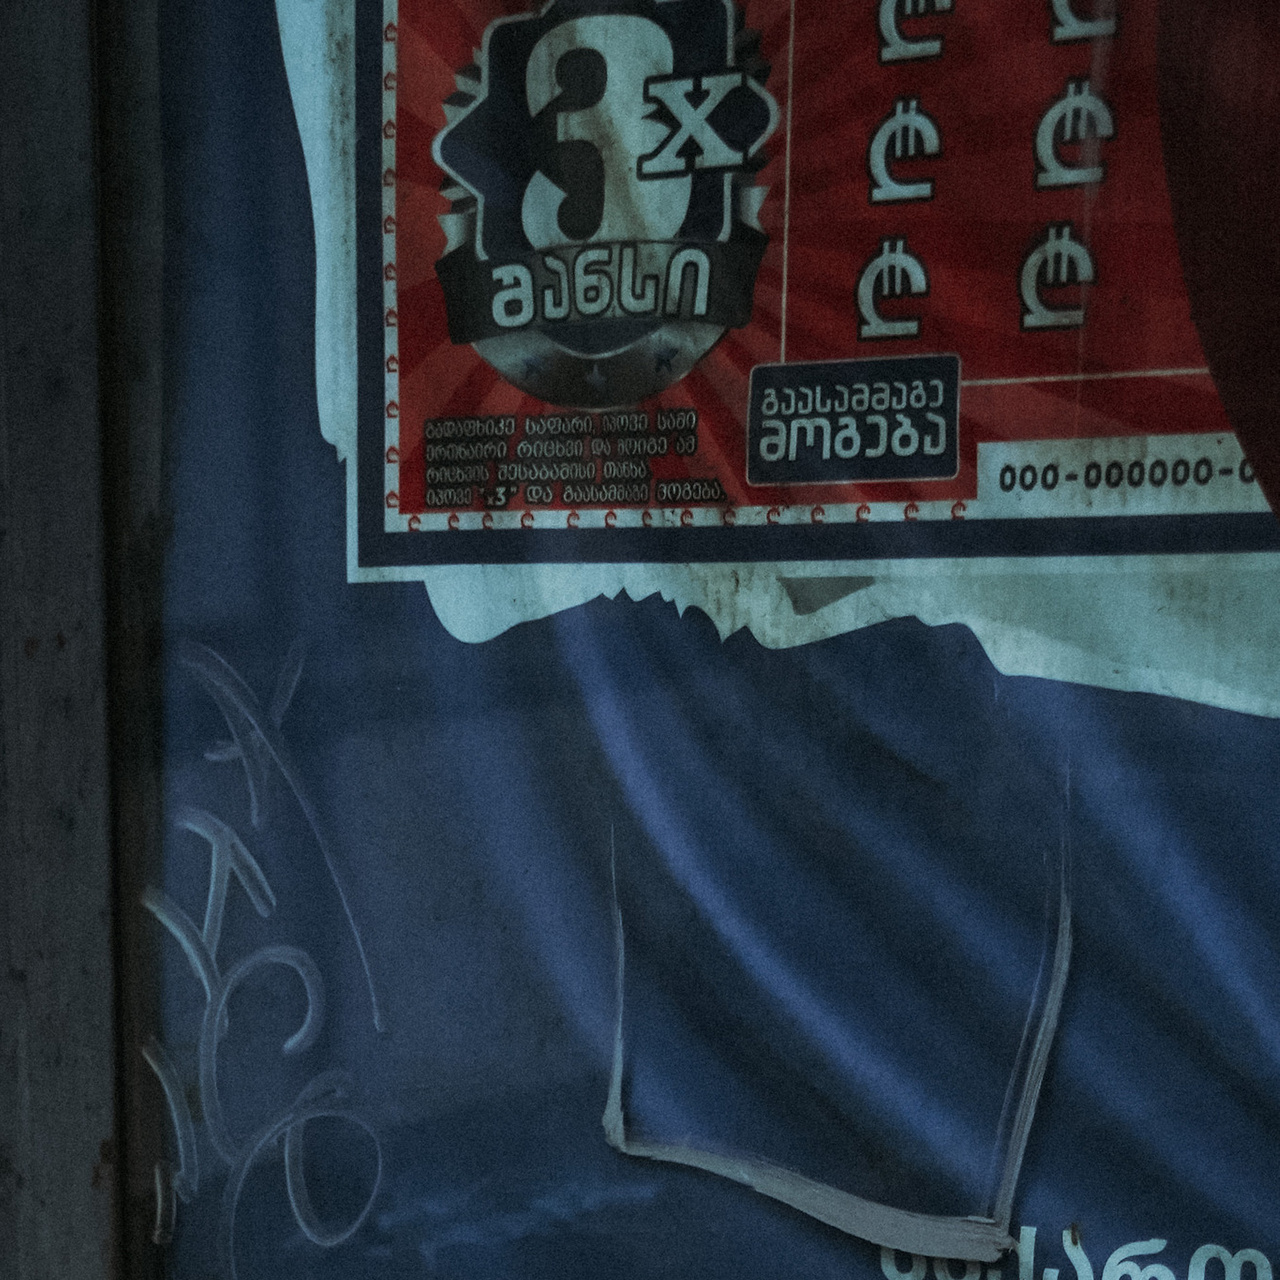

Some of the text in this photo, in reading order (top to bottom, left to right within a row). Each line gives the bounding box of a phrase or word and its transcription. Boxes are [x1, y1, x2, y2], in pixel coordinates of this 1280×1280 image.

[490, 247, 711, 329] შანსი
[761, 378, 944, 416] გაასამმაგე
[759, 411, 947, 462] მოგება
